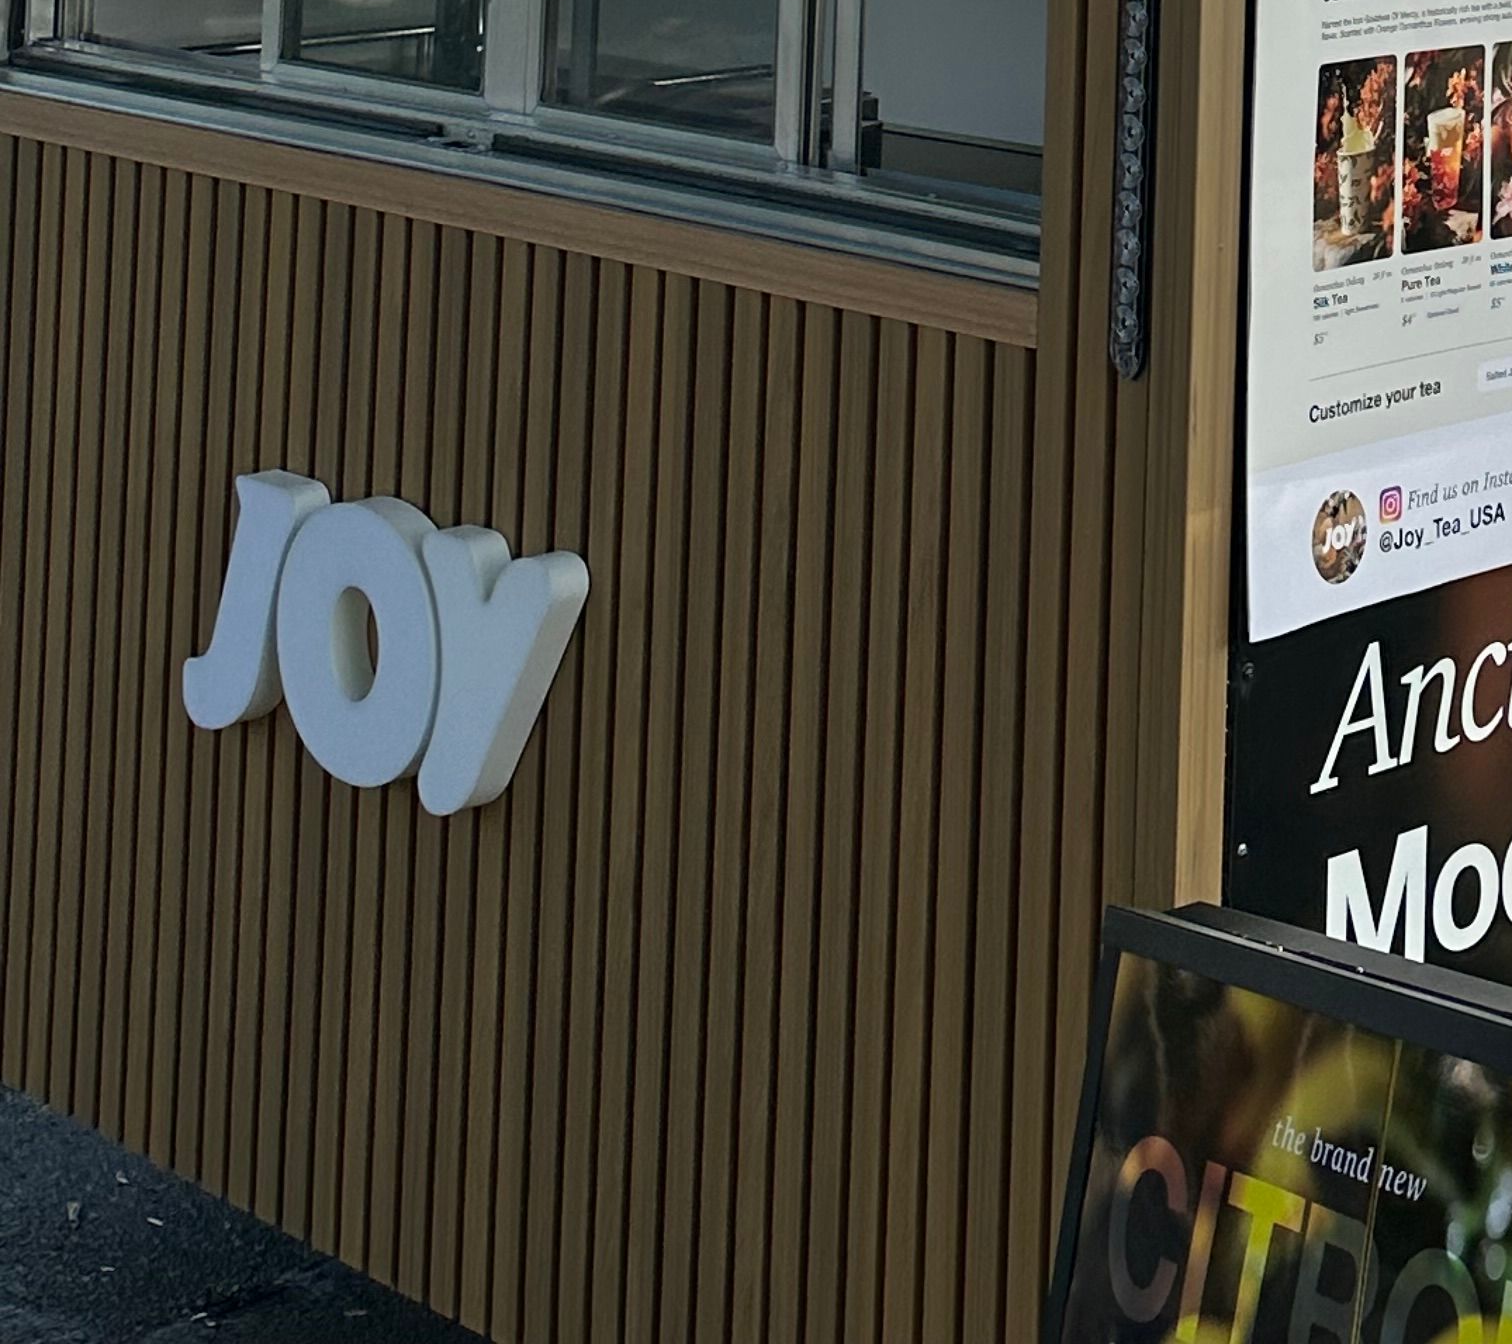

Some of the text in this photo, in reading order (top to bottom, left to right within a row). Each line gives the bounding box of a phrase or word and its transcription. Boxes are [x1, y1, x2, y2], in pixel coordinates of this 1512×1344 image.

[1313, 293, 1349, 310] Silk Tea
[1401, 274, 1442, 292] Pure Tea
[1308, 380, 1442, 424] Customize your tea
[1407, 483, 1440, 511] Find
[1442, 485, 1459, 500] us
[1461, 477, 1480, 496] on
[1321, 515, 1356, 555] JOY
[1379, 501, 1506, 554] @Joy_Tea_USA
[182, 468, 591, 817] JOY
[1271, 1115, 1428, 1204] the brand new
